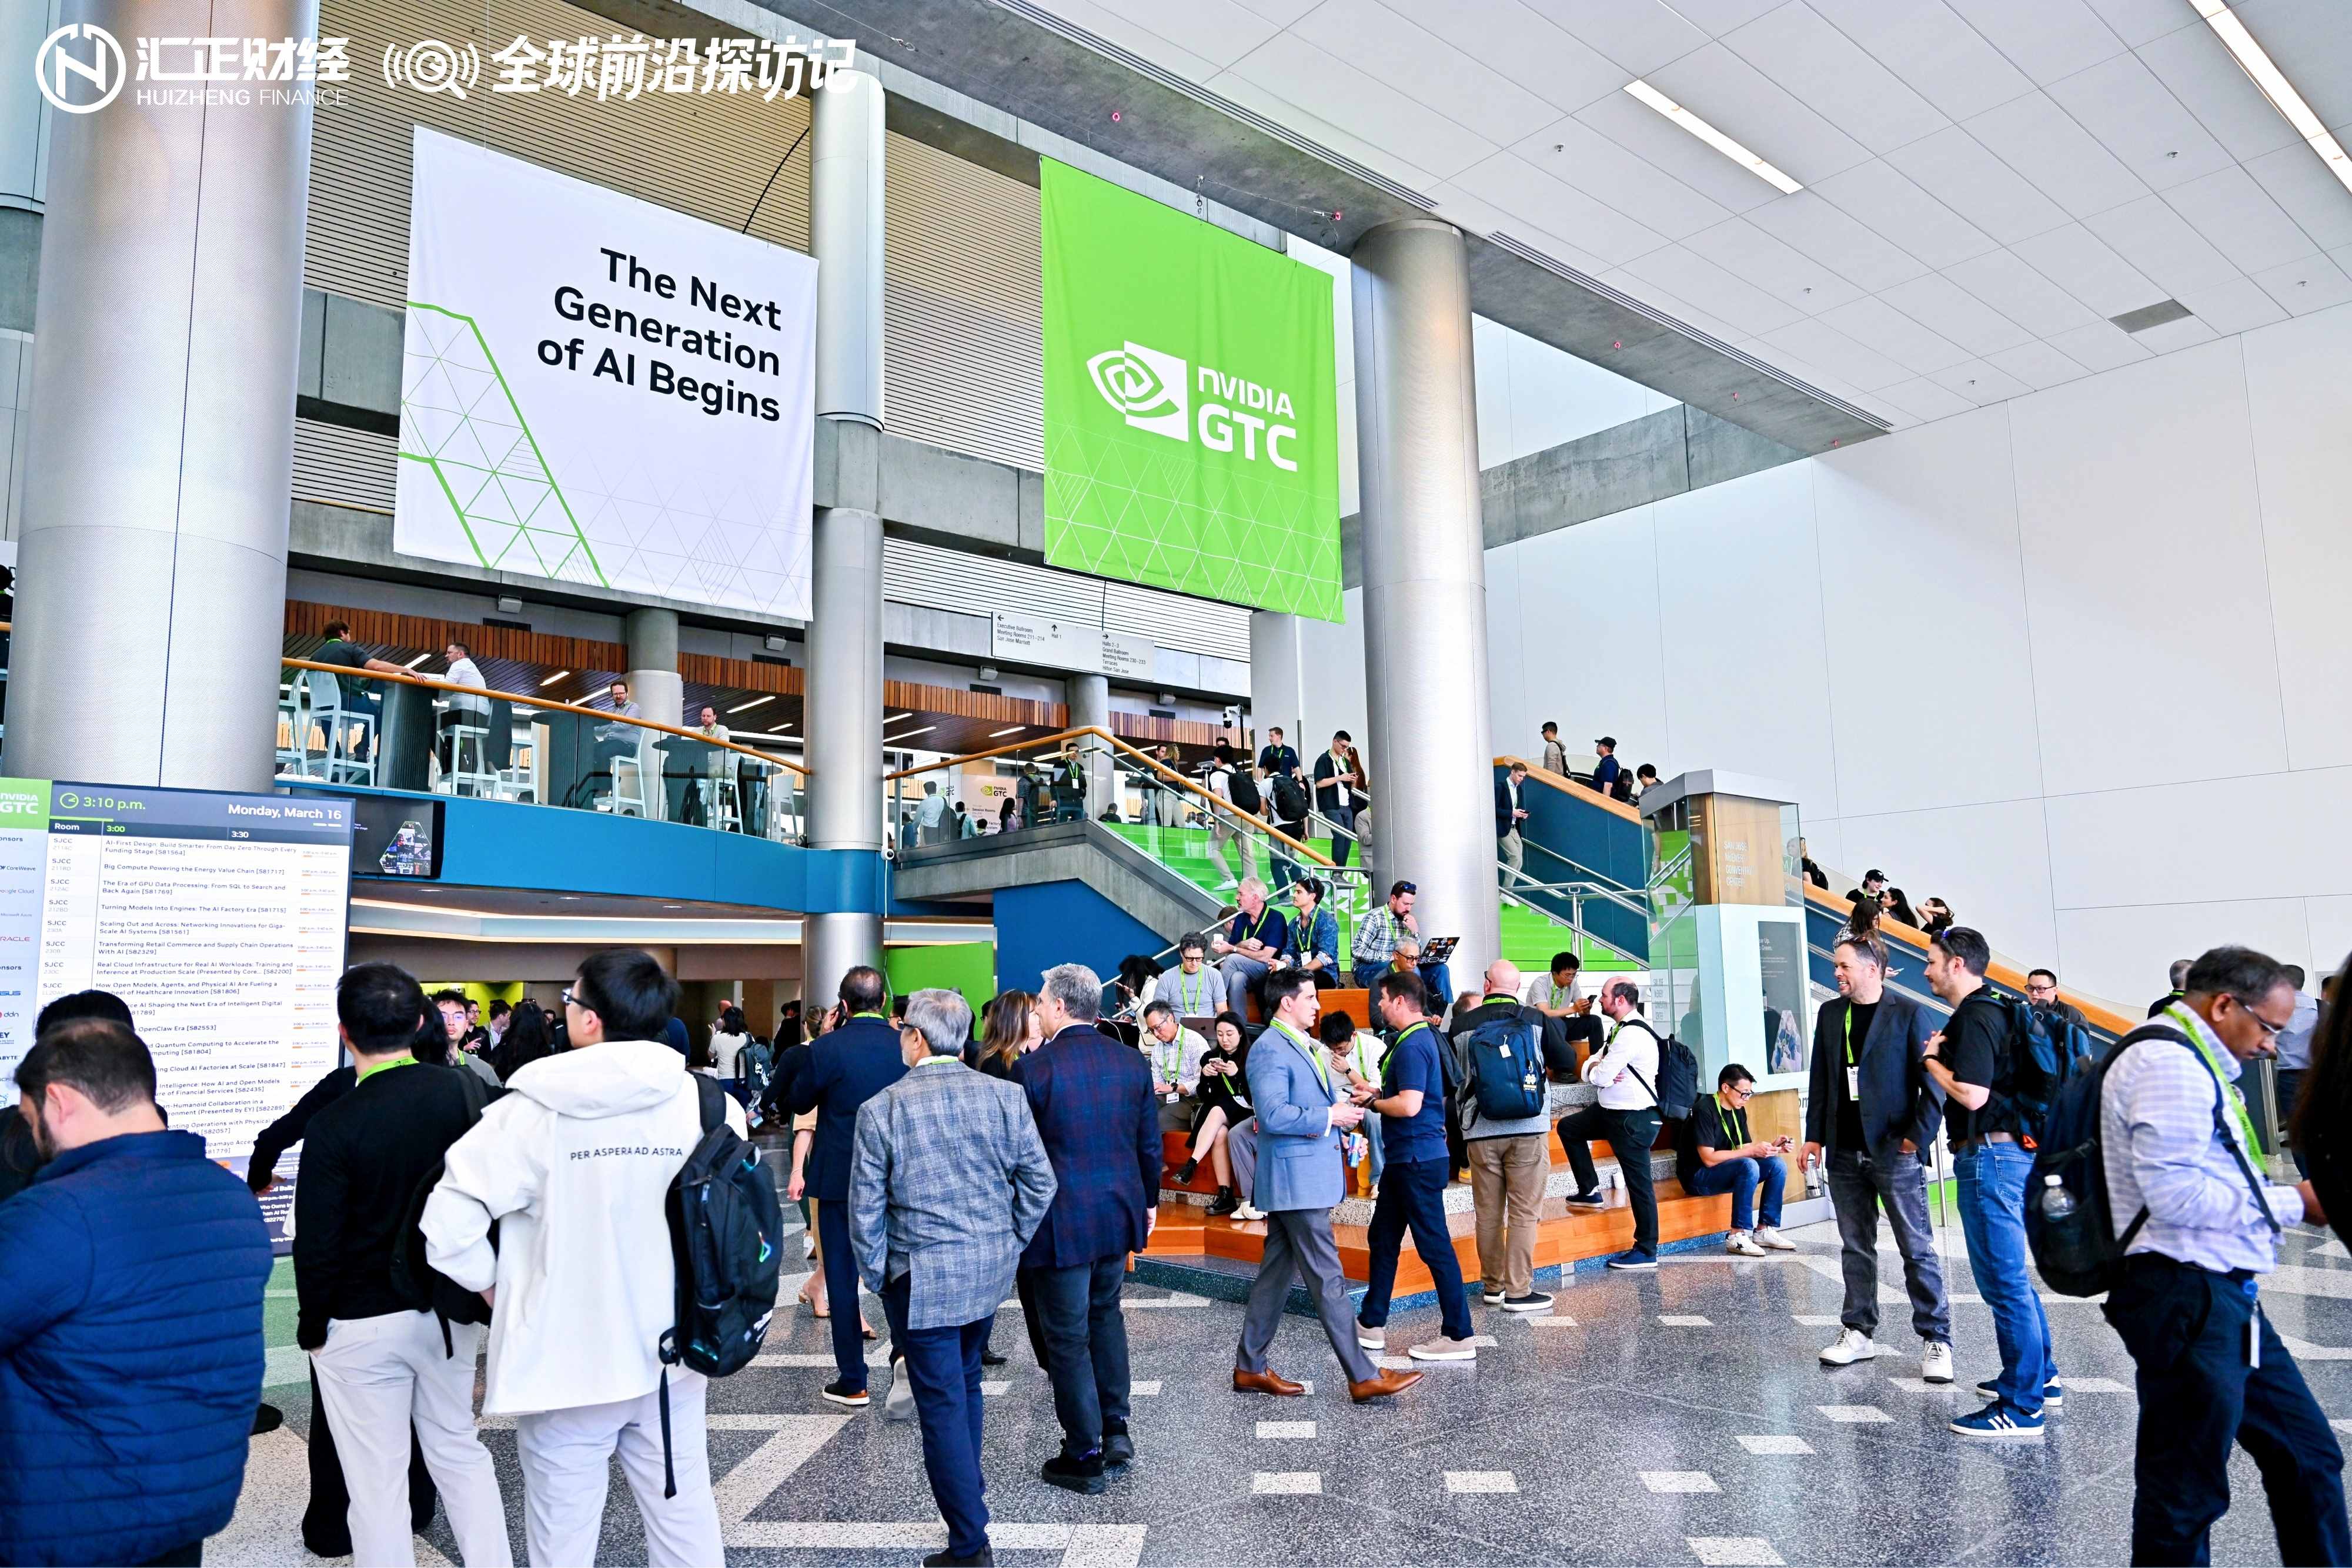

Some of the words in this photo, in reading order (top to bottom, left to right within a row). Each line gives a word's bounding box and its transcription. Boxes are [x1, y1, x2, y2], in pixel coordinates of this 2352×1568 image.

[600, 248, 676, 299] The
[690, 276, 781, 332] Next
[554, 286, 780, 376] Generation
[537, 338, 584, 371] of
[593, 347, 635, 386] AI
[650, 359, 780, 422] Begins
[1198, 365, 1295, 420] NVIDIA
[1198, 403, 1298, 473] GTC
[997, 622, 1015, 630] Executive
[997, 628, 1013, 637] Meeting
[0, 801, 38, 814] GTC
[83, 797, 114, 808] 3:10
[118, 798, 145, 811] p.m.
[228, 804, 281, 818] Monday,
[285, 807, 323, 819] March
[328, 810, 342, 820] 16
[105, 839, 132, 847] AI-First
[105, 846, 132, 855] Funding
[570, 1151, 590, 1161] PER
[593, 1147, 632, 1157] ASPERA
[634, 1147, 649, 1155] AD
[652, 1148, 683, 1156] ASTRA
